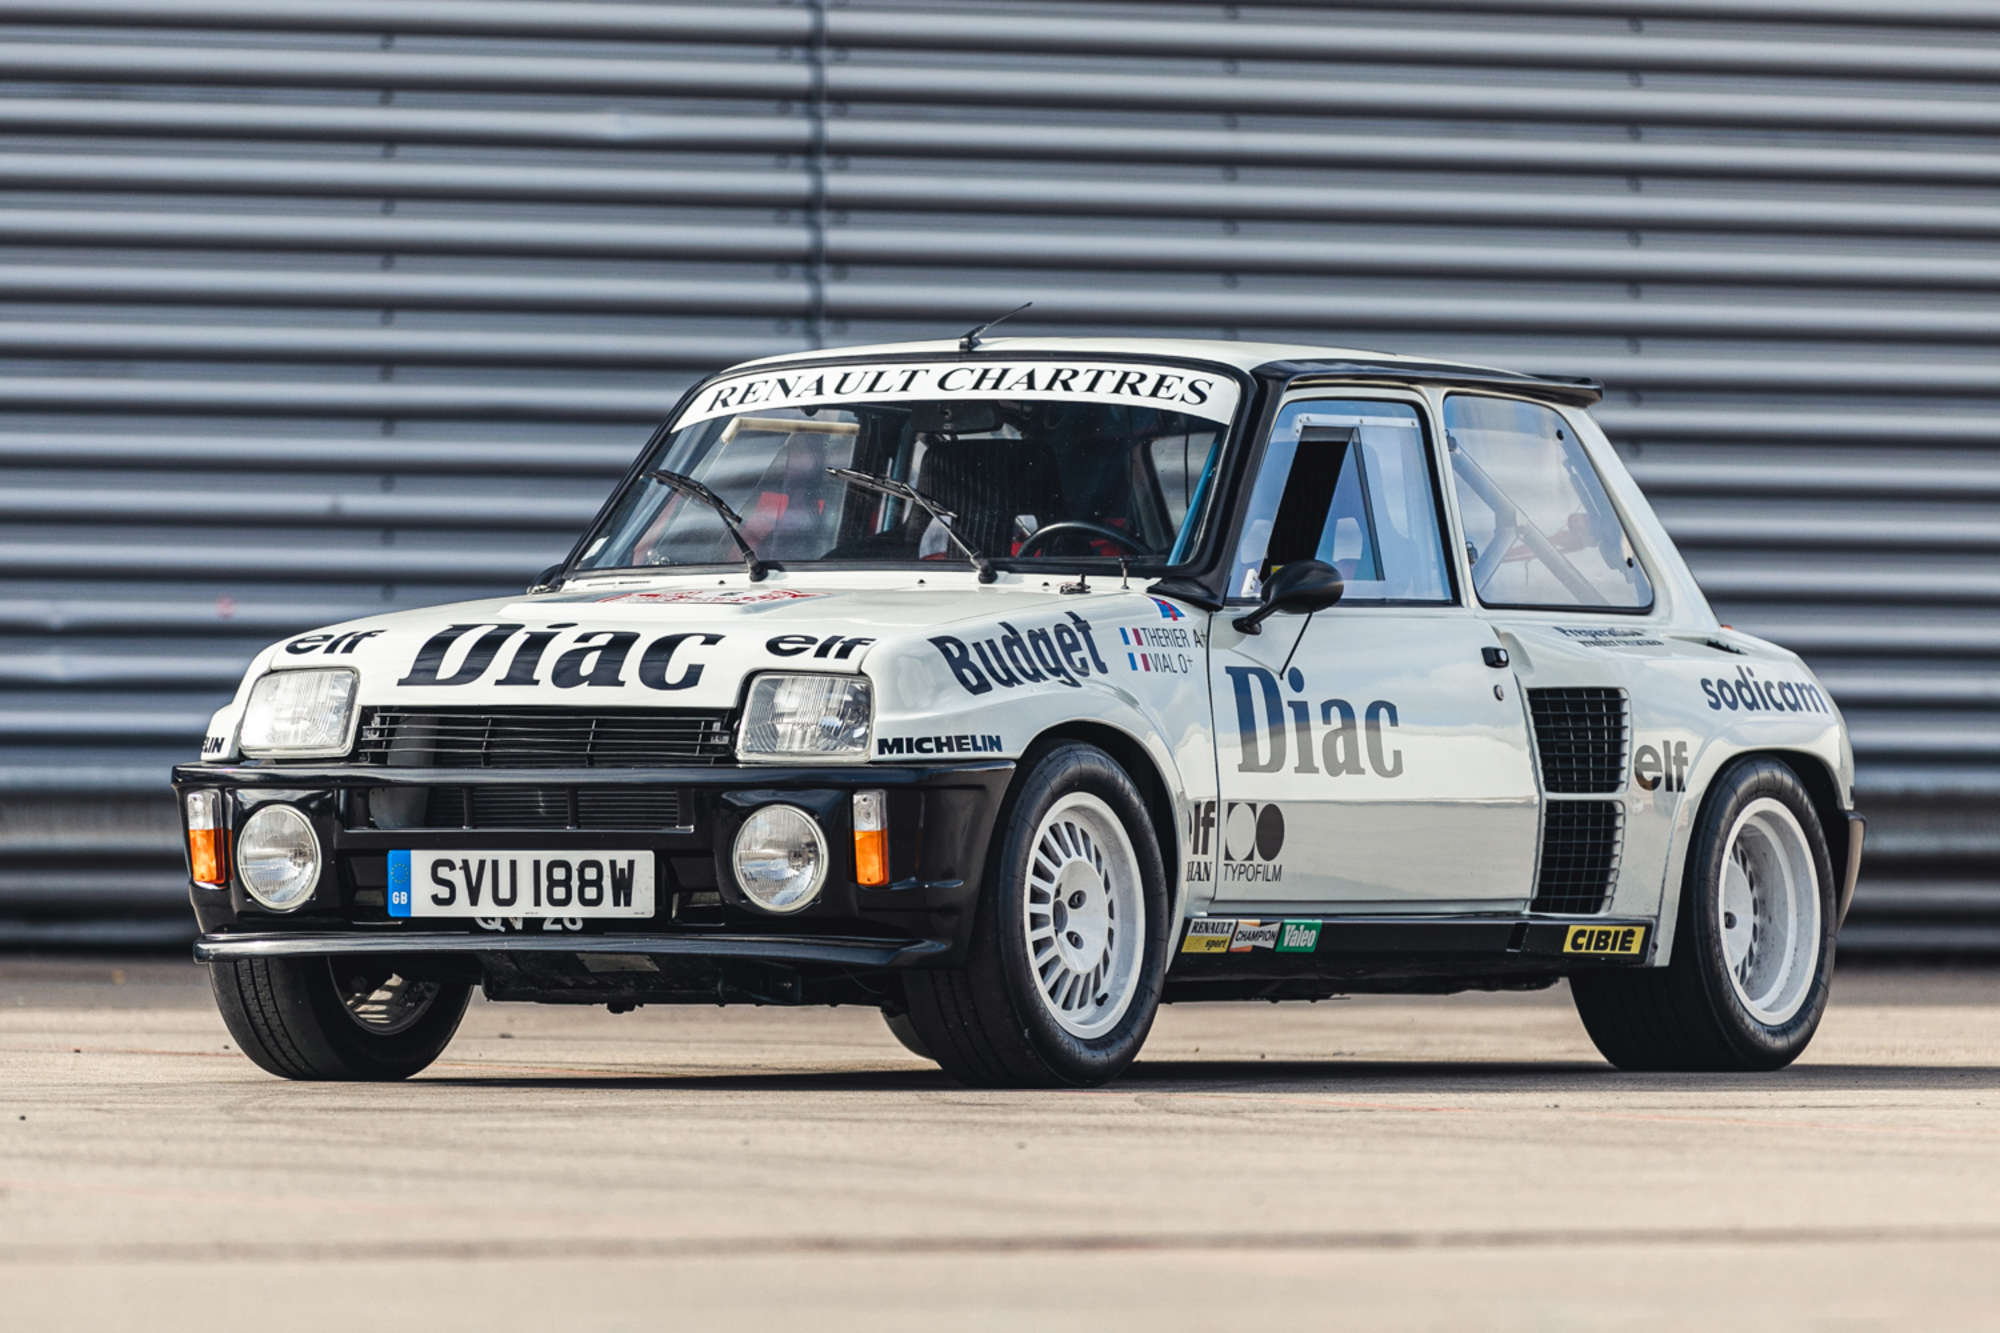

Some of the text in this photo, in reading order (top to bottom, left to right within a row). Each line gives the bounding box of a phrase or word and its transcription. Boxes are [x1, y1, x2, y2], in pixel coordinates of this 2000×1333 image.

[706, 367, 1213, 413] RENAULT CHARTRES
[285, 629, 388, 655] elf
[765, 634, 877, 660] elf
[1140, 627, 1191, 649] THERIER
[397, 622, 727, 690] Diac
[927, 611, 1108, 695] Budget
[1148, 652, 1178, 674] VIAL
[1700, 664, 1829, 714] sodicam
[1225, 665, 1404, 779] Diac
[877, 734, 1003, 755] MICHELIN
[1634, 739, 1689, 793] elf
[1187, 800, 1217, 856] lf
[430, 858, 636, 907] SVU 188W
[1223, 863, 1283, 882] TYPOFILM
[391, 891, 408, 905] GB
[1190, 920, 1234, 935] RENAULT
[1235, 928, 1278, 942] CHAMPION
[1283, 924, 1317, 948] Valeo
